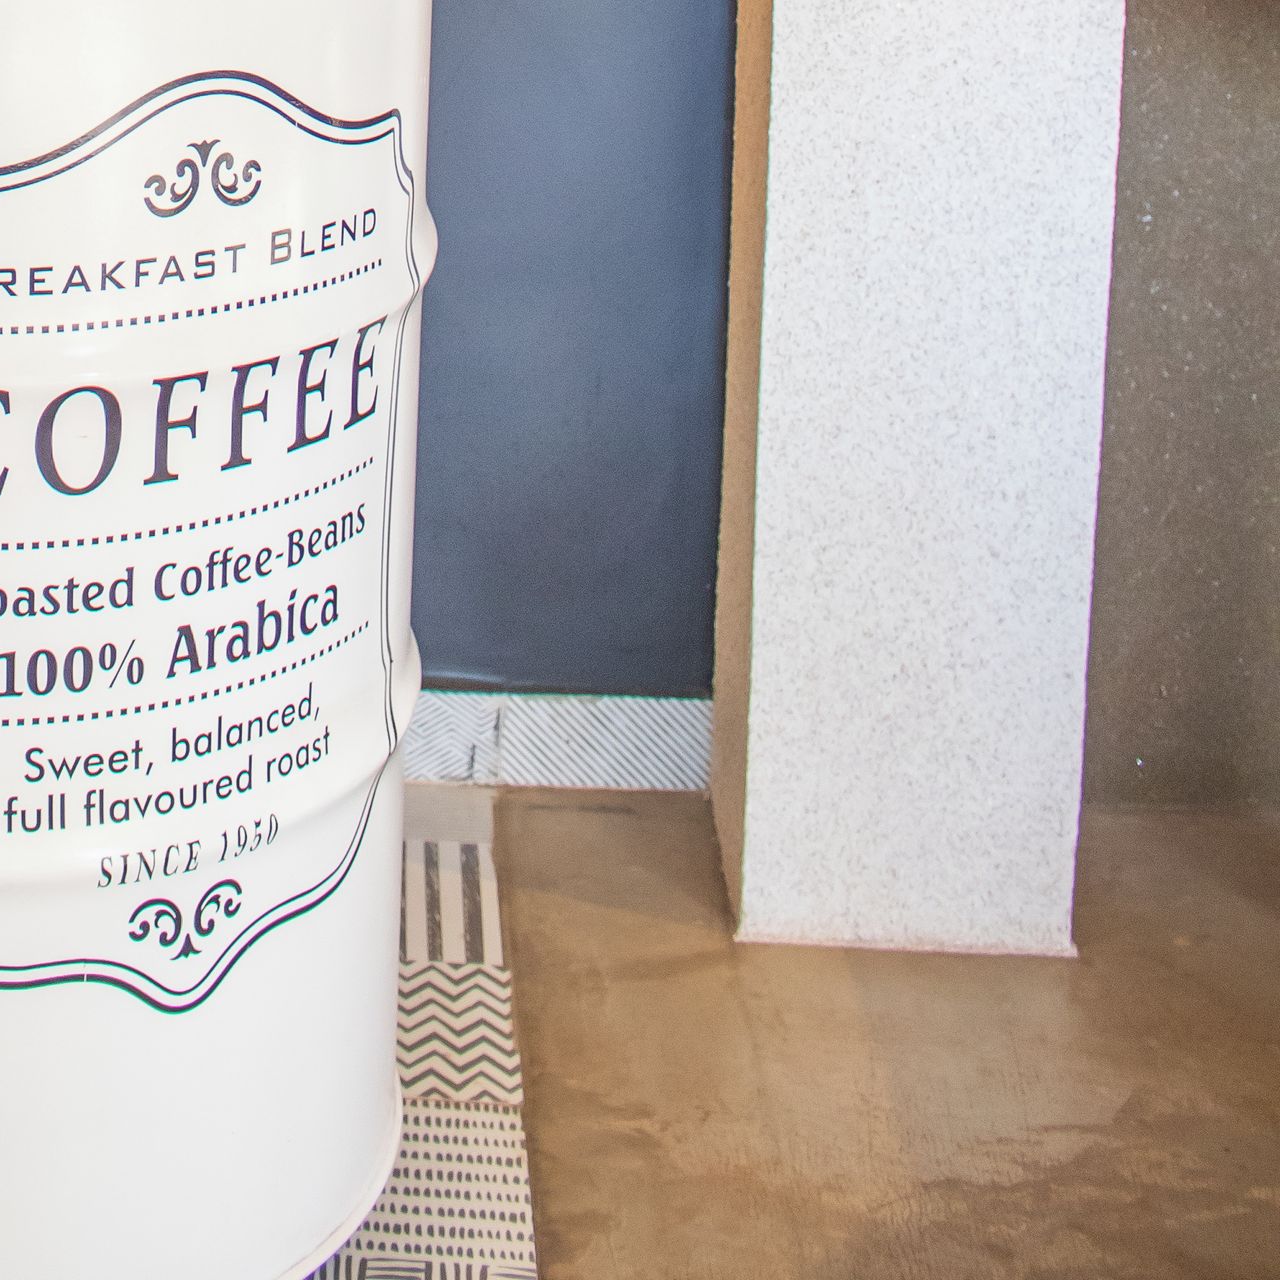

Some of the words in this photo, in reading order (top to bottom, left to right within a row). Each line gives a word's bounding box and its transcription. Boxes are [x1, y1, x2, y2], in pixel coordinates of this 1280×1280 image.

[270, 208, 378, 266] BLEND
[153, 502, 367, 601] Coffee-Beans
[4, 793, 66, 834] full
[83, 757, 254, 827] flavoured
[265, 727, 332, 784] roast
[24, 739, 154, 782] Sweet,
[171, 683, 321, 763] balanced,
[97, 840, 202, 888] SINCE
[218, 812, 280, 864] 1950
